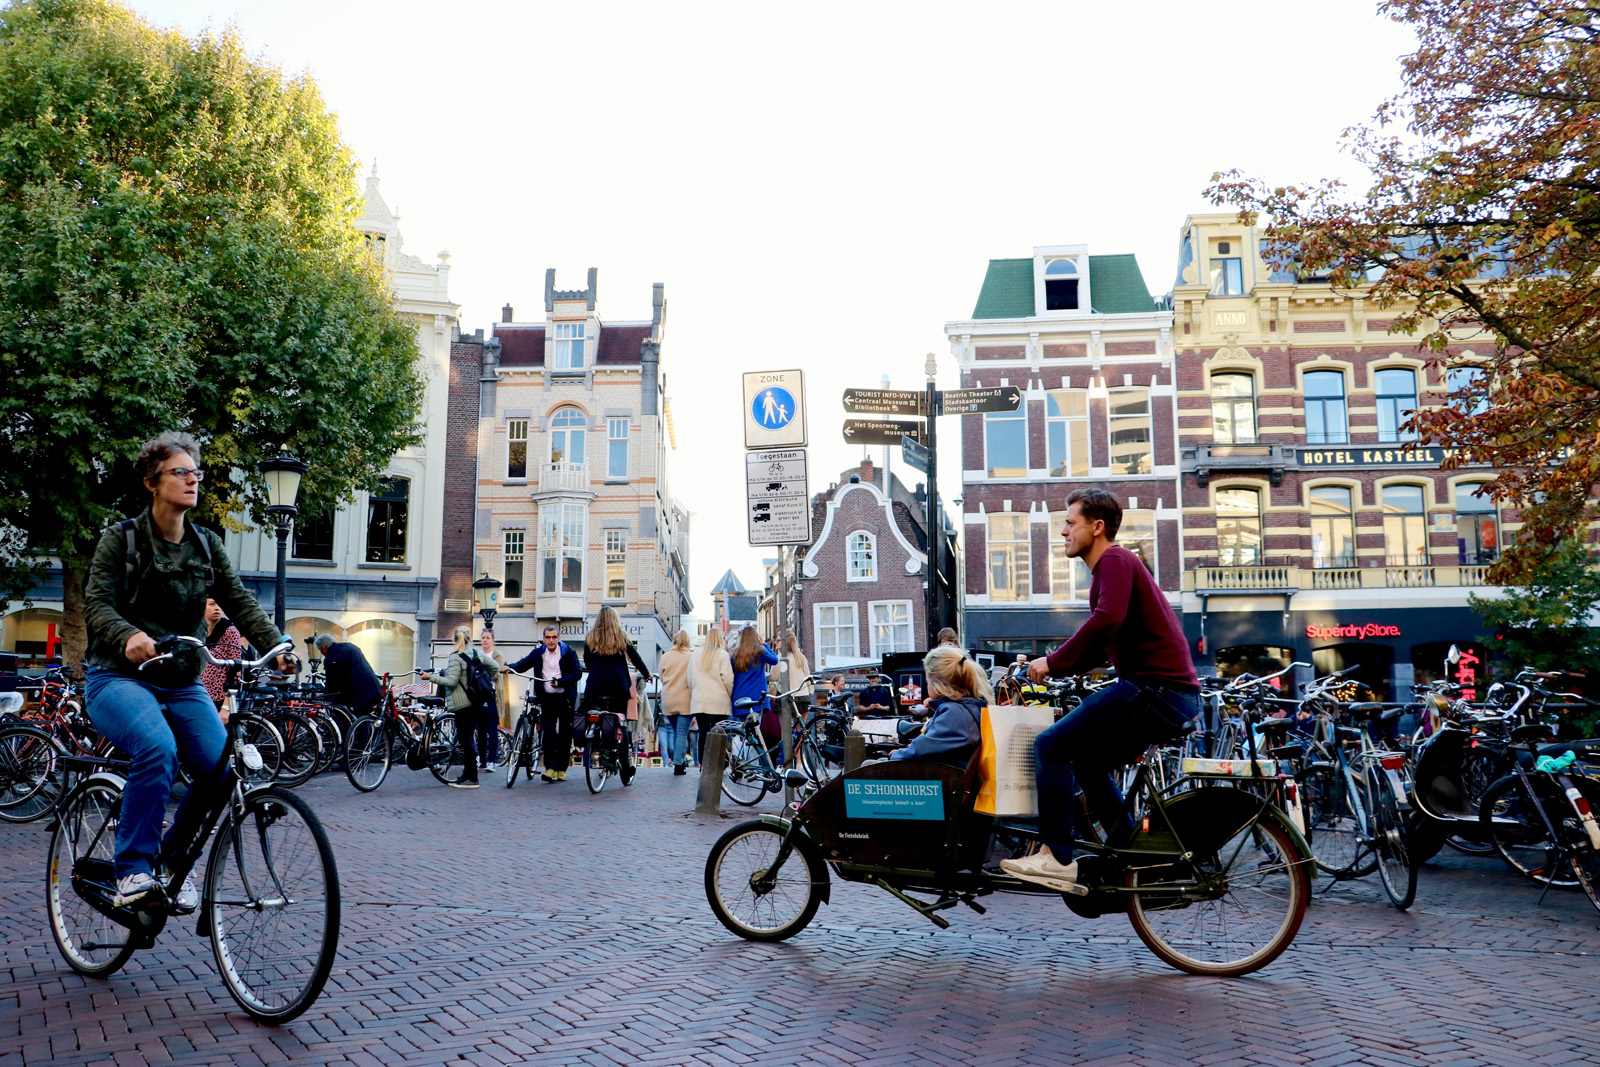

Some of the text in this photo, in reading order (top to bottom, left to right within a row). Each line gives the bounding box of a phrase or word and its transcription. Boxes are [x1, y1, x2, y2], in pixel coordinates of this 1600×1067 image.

[1215, 312, 1246, 326] ANNO
[760, 374, 785, 383] ZONE
[868, 422, 901, 430] Spoorweg-
[1304, 452, 1355, 464] HOTEL
[1362, 450, 1435, 463] KASTEEL
[848, 784, 939, 796] DE SCHOONHORST
